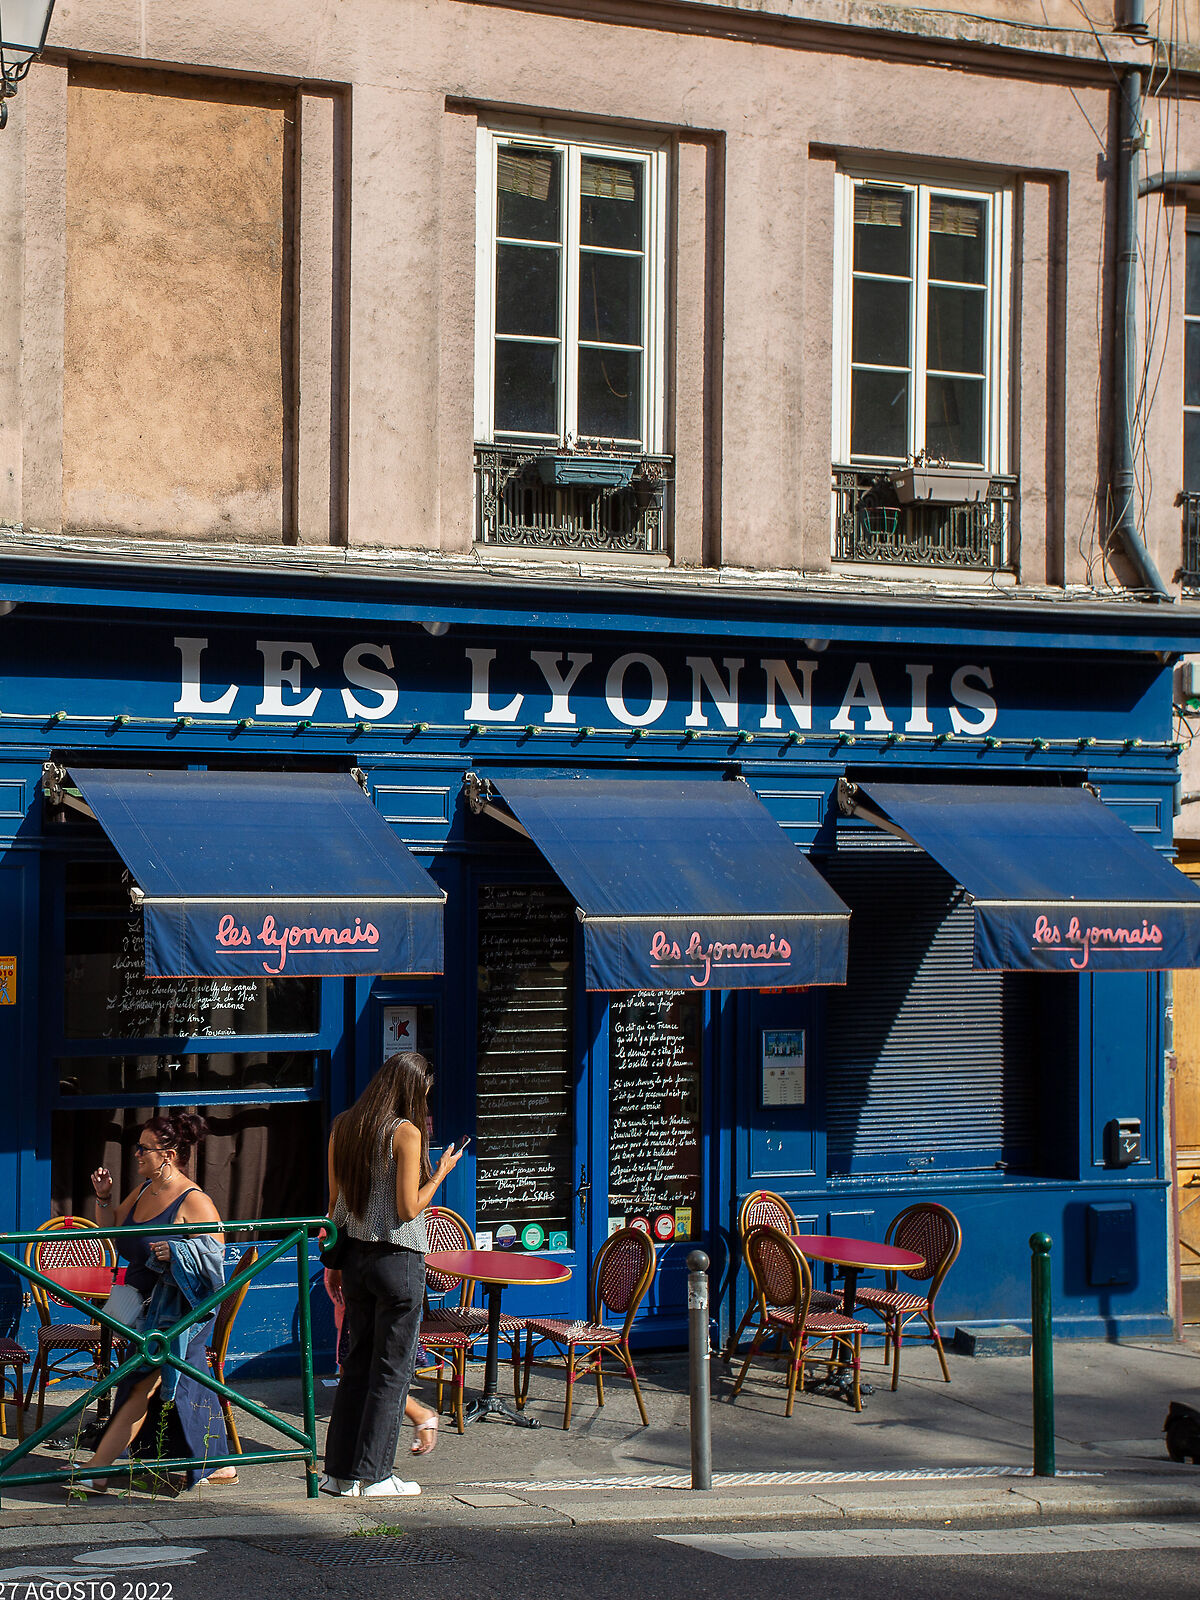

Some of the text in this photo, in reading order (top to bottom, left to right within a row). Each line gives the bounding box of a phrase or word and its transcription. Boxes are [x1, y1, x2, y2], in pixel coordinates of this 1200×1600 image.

[173, 637, 998, 736] LES LYONNAIS
[215, 914, 380, 974] les lyonnais
[650, 930, 792, 987] les lyonnais
[1032, 915, 1163, 969] les lyonnais
[656, 1021, 679, 1030] France
